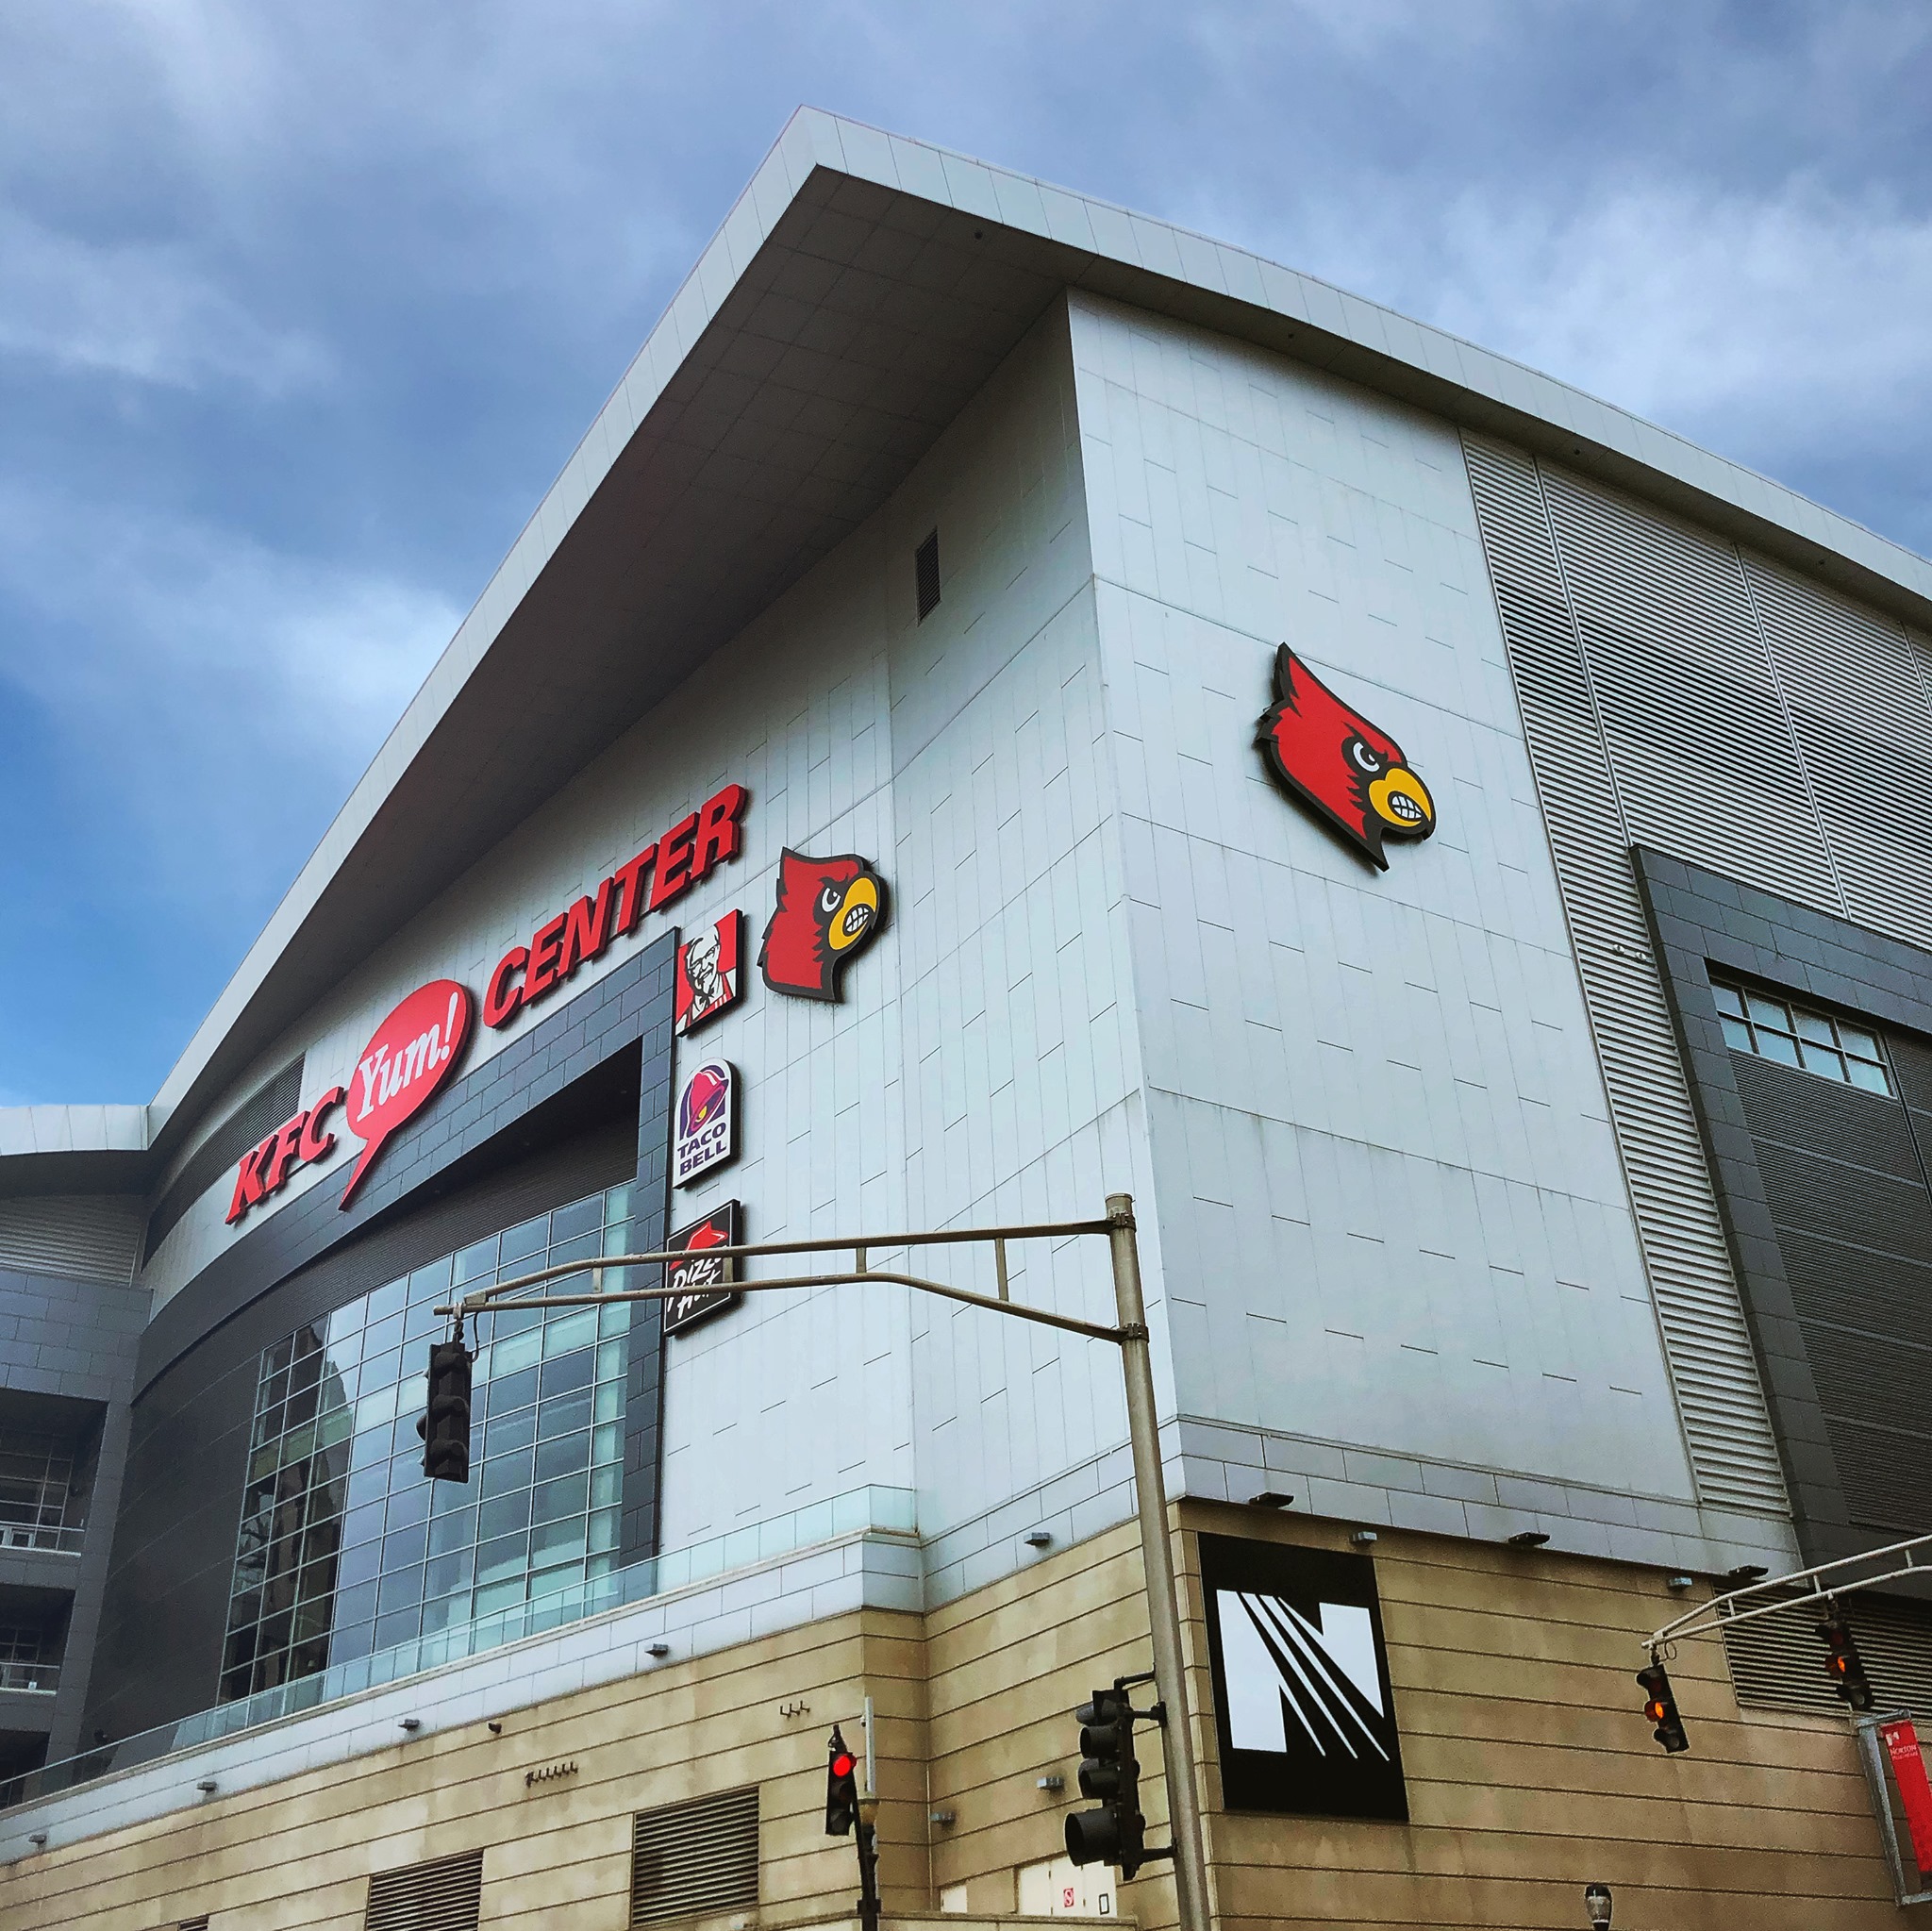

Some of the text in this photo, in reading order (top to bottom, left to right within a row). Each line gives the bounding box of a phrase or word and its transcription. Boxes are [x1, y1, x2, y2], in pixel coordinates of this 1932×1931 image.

[225, 783, 748, 1224] KFC Yum! CENTER
[676, 1122, 727, 1159] TACO
[679, 1140, 727, 1176] BELL
